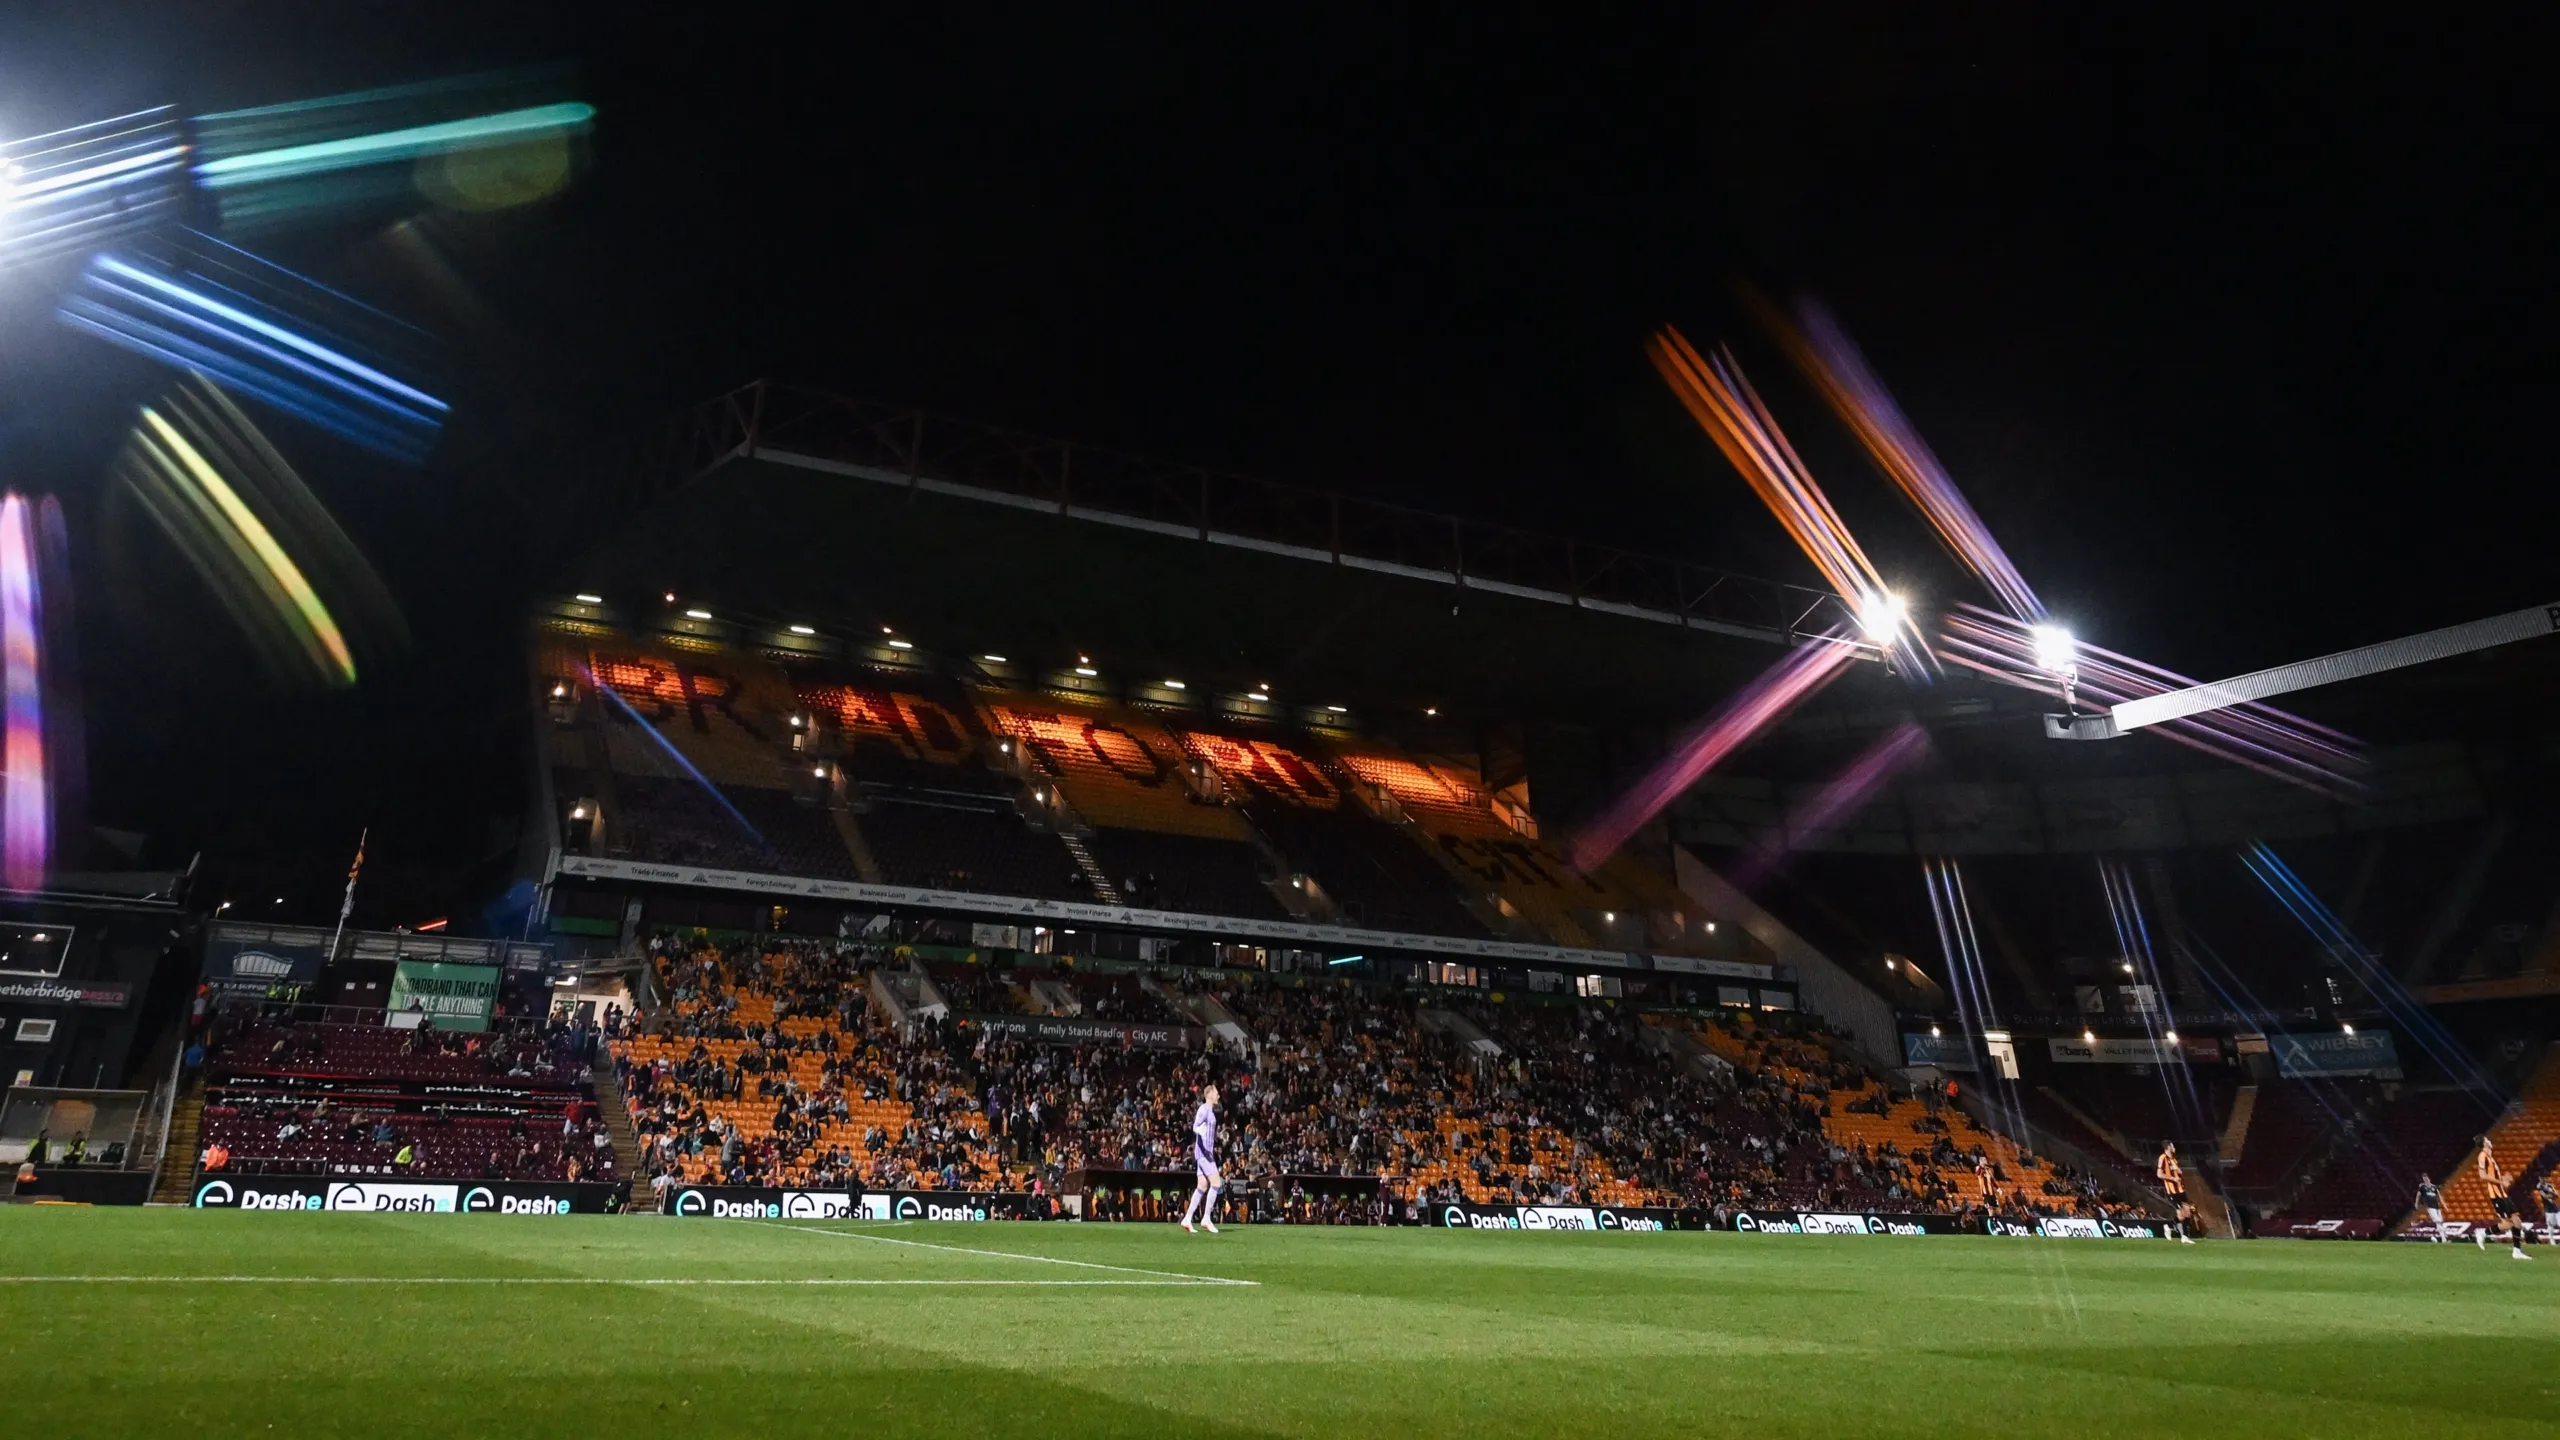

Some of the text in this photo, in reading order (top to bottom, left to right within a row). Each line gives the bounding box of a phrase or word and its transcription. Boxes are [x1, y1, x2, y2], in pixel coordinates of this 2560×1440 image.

[651, 869, 679, 878] Finance
[395, 977, 497, 998] BROADBAND THAT CAN
[436, 996, 484, 1015] ANYTHING
[1039, 1024, 1065, 1037] Family
[1068, 1025, 1093, 1038] Stand
[1094, 1026, 1125, 1039] Bradfor
[1132, 1029, 1149, 1043] City
[1151, 1031, 1168, 1042] AFC
[2308, 1036, 2386, 1051] WIBSEY
[241, 1190, 322, 1210] Dashe
[375, 1194, 450, 1212] Dashe
[501, 1195, 571, 1214] Dashe
[713, 1199, 779, 1218] Dashe
[824, 1202, 886, 1220] Dashe
[928, 1204, 986, 1221] Dashe
[1470, 1212, 1519, 1229] Dashe
[1547, 1214, 1593, 1230] Dashe
[1620, 1216, 1663, 1231] Dashe
[1758, 1219, 1801, 1233] Dashe
[1825, 1221, 1864, 1234] Dashe
[1888, 1222, 1926, 1234] Dashe
[2006, 1223, 2044, 1236] Dase
[2064, 1225, 2100, 1238] Dashe
[2119, 1226, 2154, 1238] Dashe
